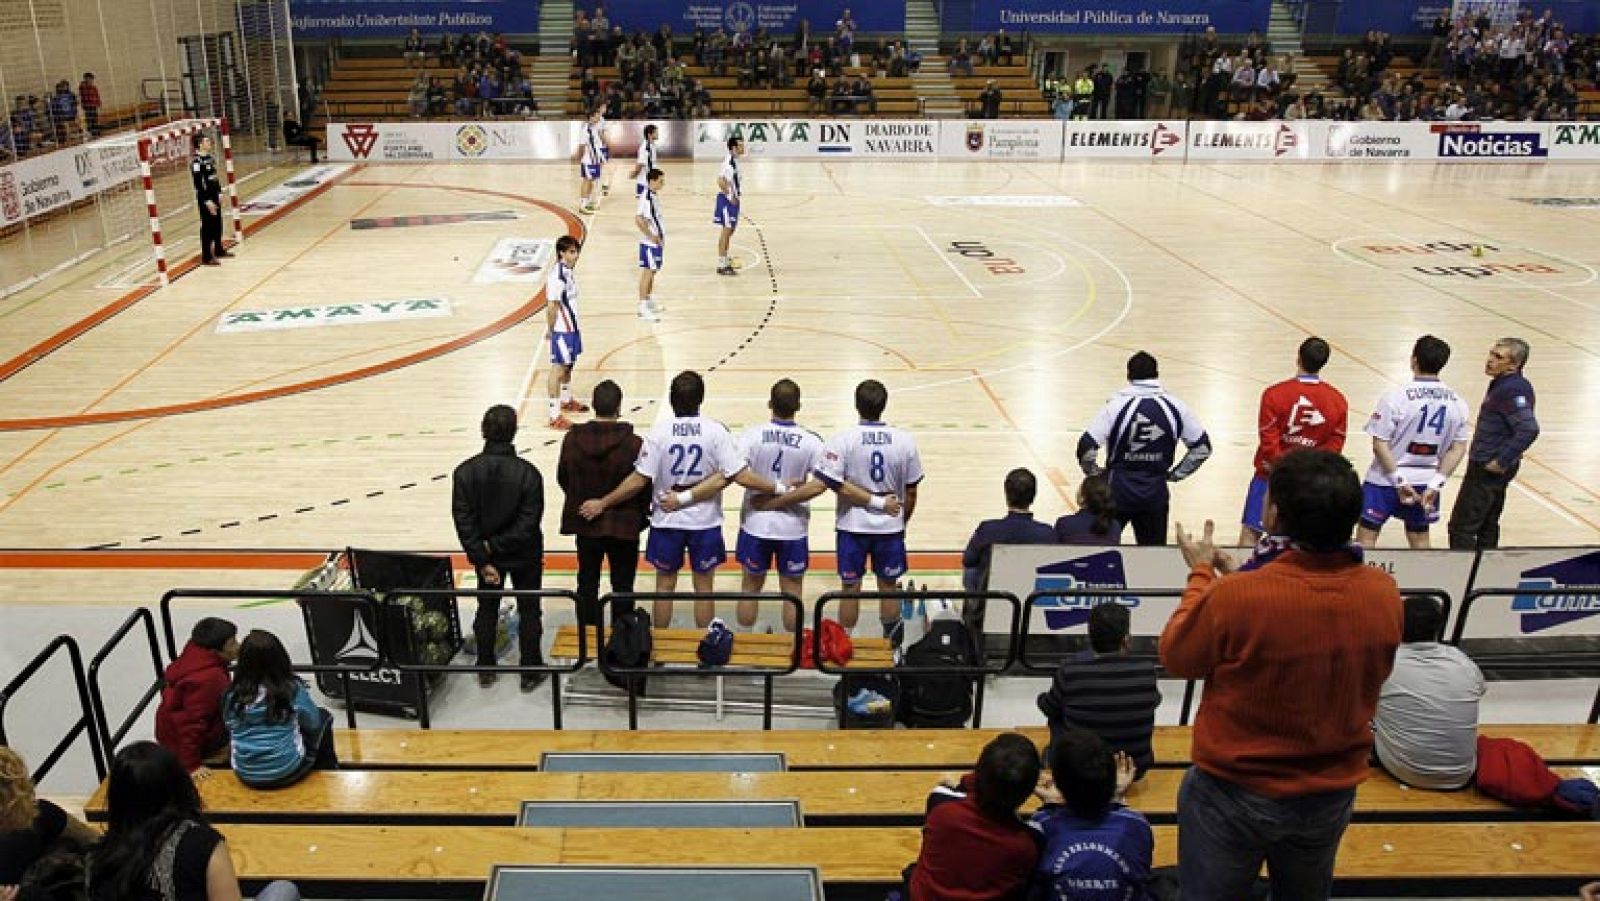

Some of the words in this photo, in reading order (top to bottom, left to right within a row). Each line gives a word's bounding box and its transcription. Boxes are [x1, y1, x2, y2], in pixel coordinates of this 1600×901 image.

[1000, 10, 1080, 24] Universidad
[1083, 9, 1133, 24] Pública
[1136, 10, 1153, 24] de
[1157, 11, 1210, 24] Navarra
[820, 124, 851, 142] DN
[865, 124, 912, 136] DIARIO
[914, 124, 934, 136] DE
[1349, 134, 1401, 144] Gobierno
[865, 140, 934, 152] NAVARRA
[1070, 132, 1149, 147] ELEMENTS
[1442, 134, 1532, 155] Noticias
[1349, 147, 1363, 157] de
[1366, 147, 1410, 157] Navarra
[227, 299, 442, 324] AMAYA
[1416, 403, 1447, 435] 14
[668, 443, 703, 477] 22
[771, 449, 784, 476] 4
[869, 450, 885, 483] 8
[337, 667, 402, 685] ELECT
